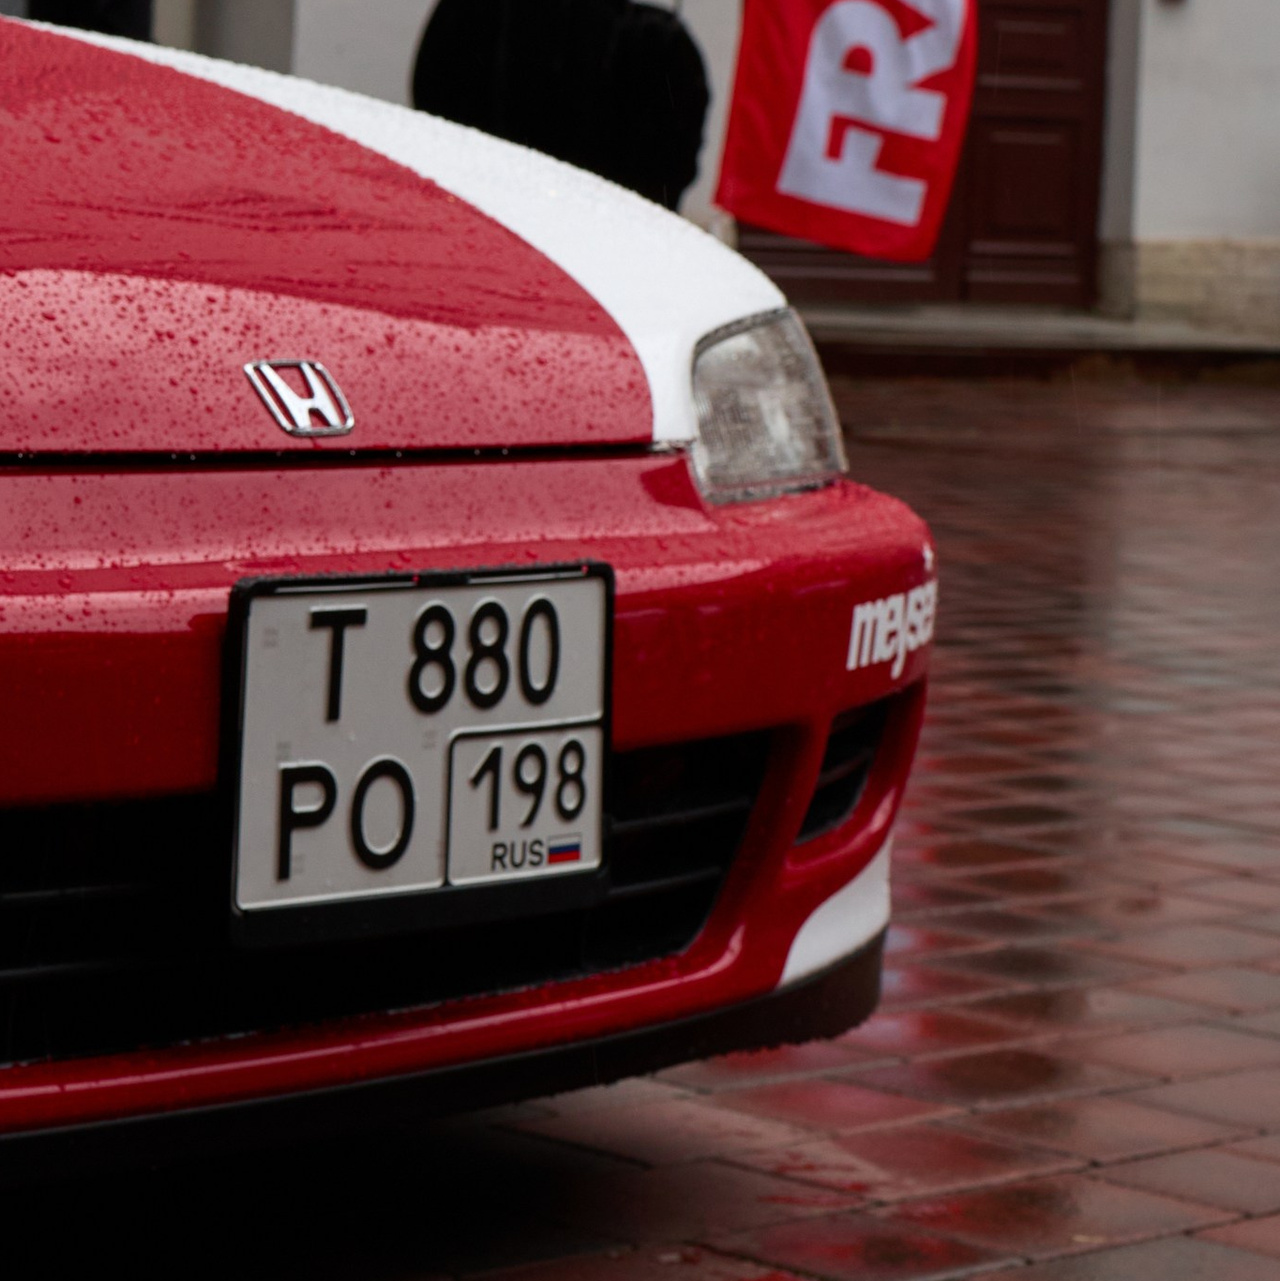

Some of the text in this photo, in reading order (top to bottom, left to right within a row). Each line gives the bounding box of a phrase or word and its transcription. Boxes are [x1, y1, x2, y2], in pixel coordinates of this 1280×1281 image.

[309, 596, 560, 724] T 880
[276, 756, 416, 880] PO
[469, 739, 587, 831] 198
[491, 840, 544, 871] RUS
